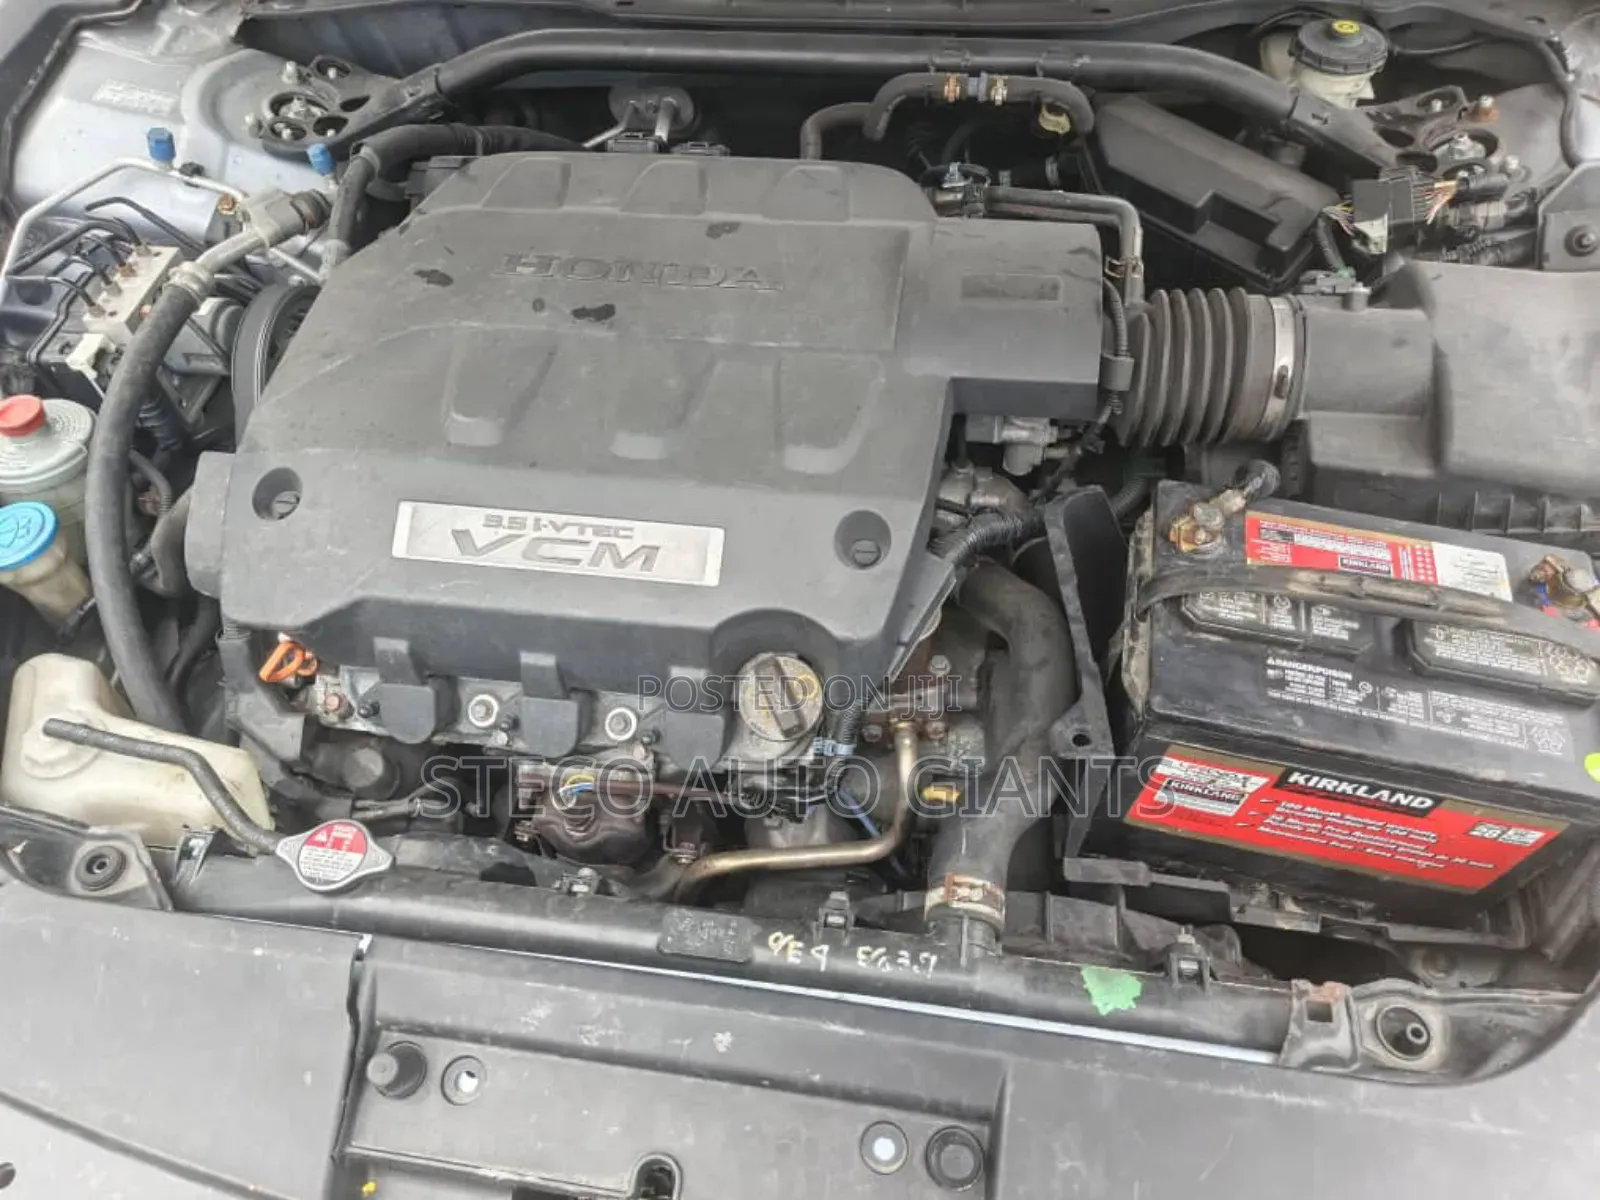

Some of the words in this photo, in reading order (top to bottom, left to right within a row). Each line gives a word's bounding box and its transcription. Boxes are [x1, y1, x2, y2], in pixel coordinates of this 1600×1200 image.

[492, 253, 784, 292] HONDA
[451, 528, 661, 572] VCM
[1287, 771, 1435, 810] KIRKLAND
